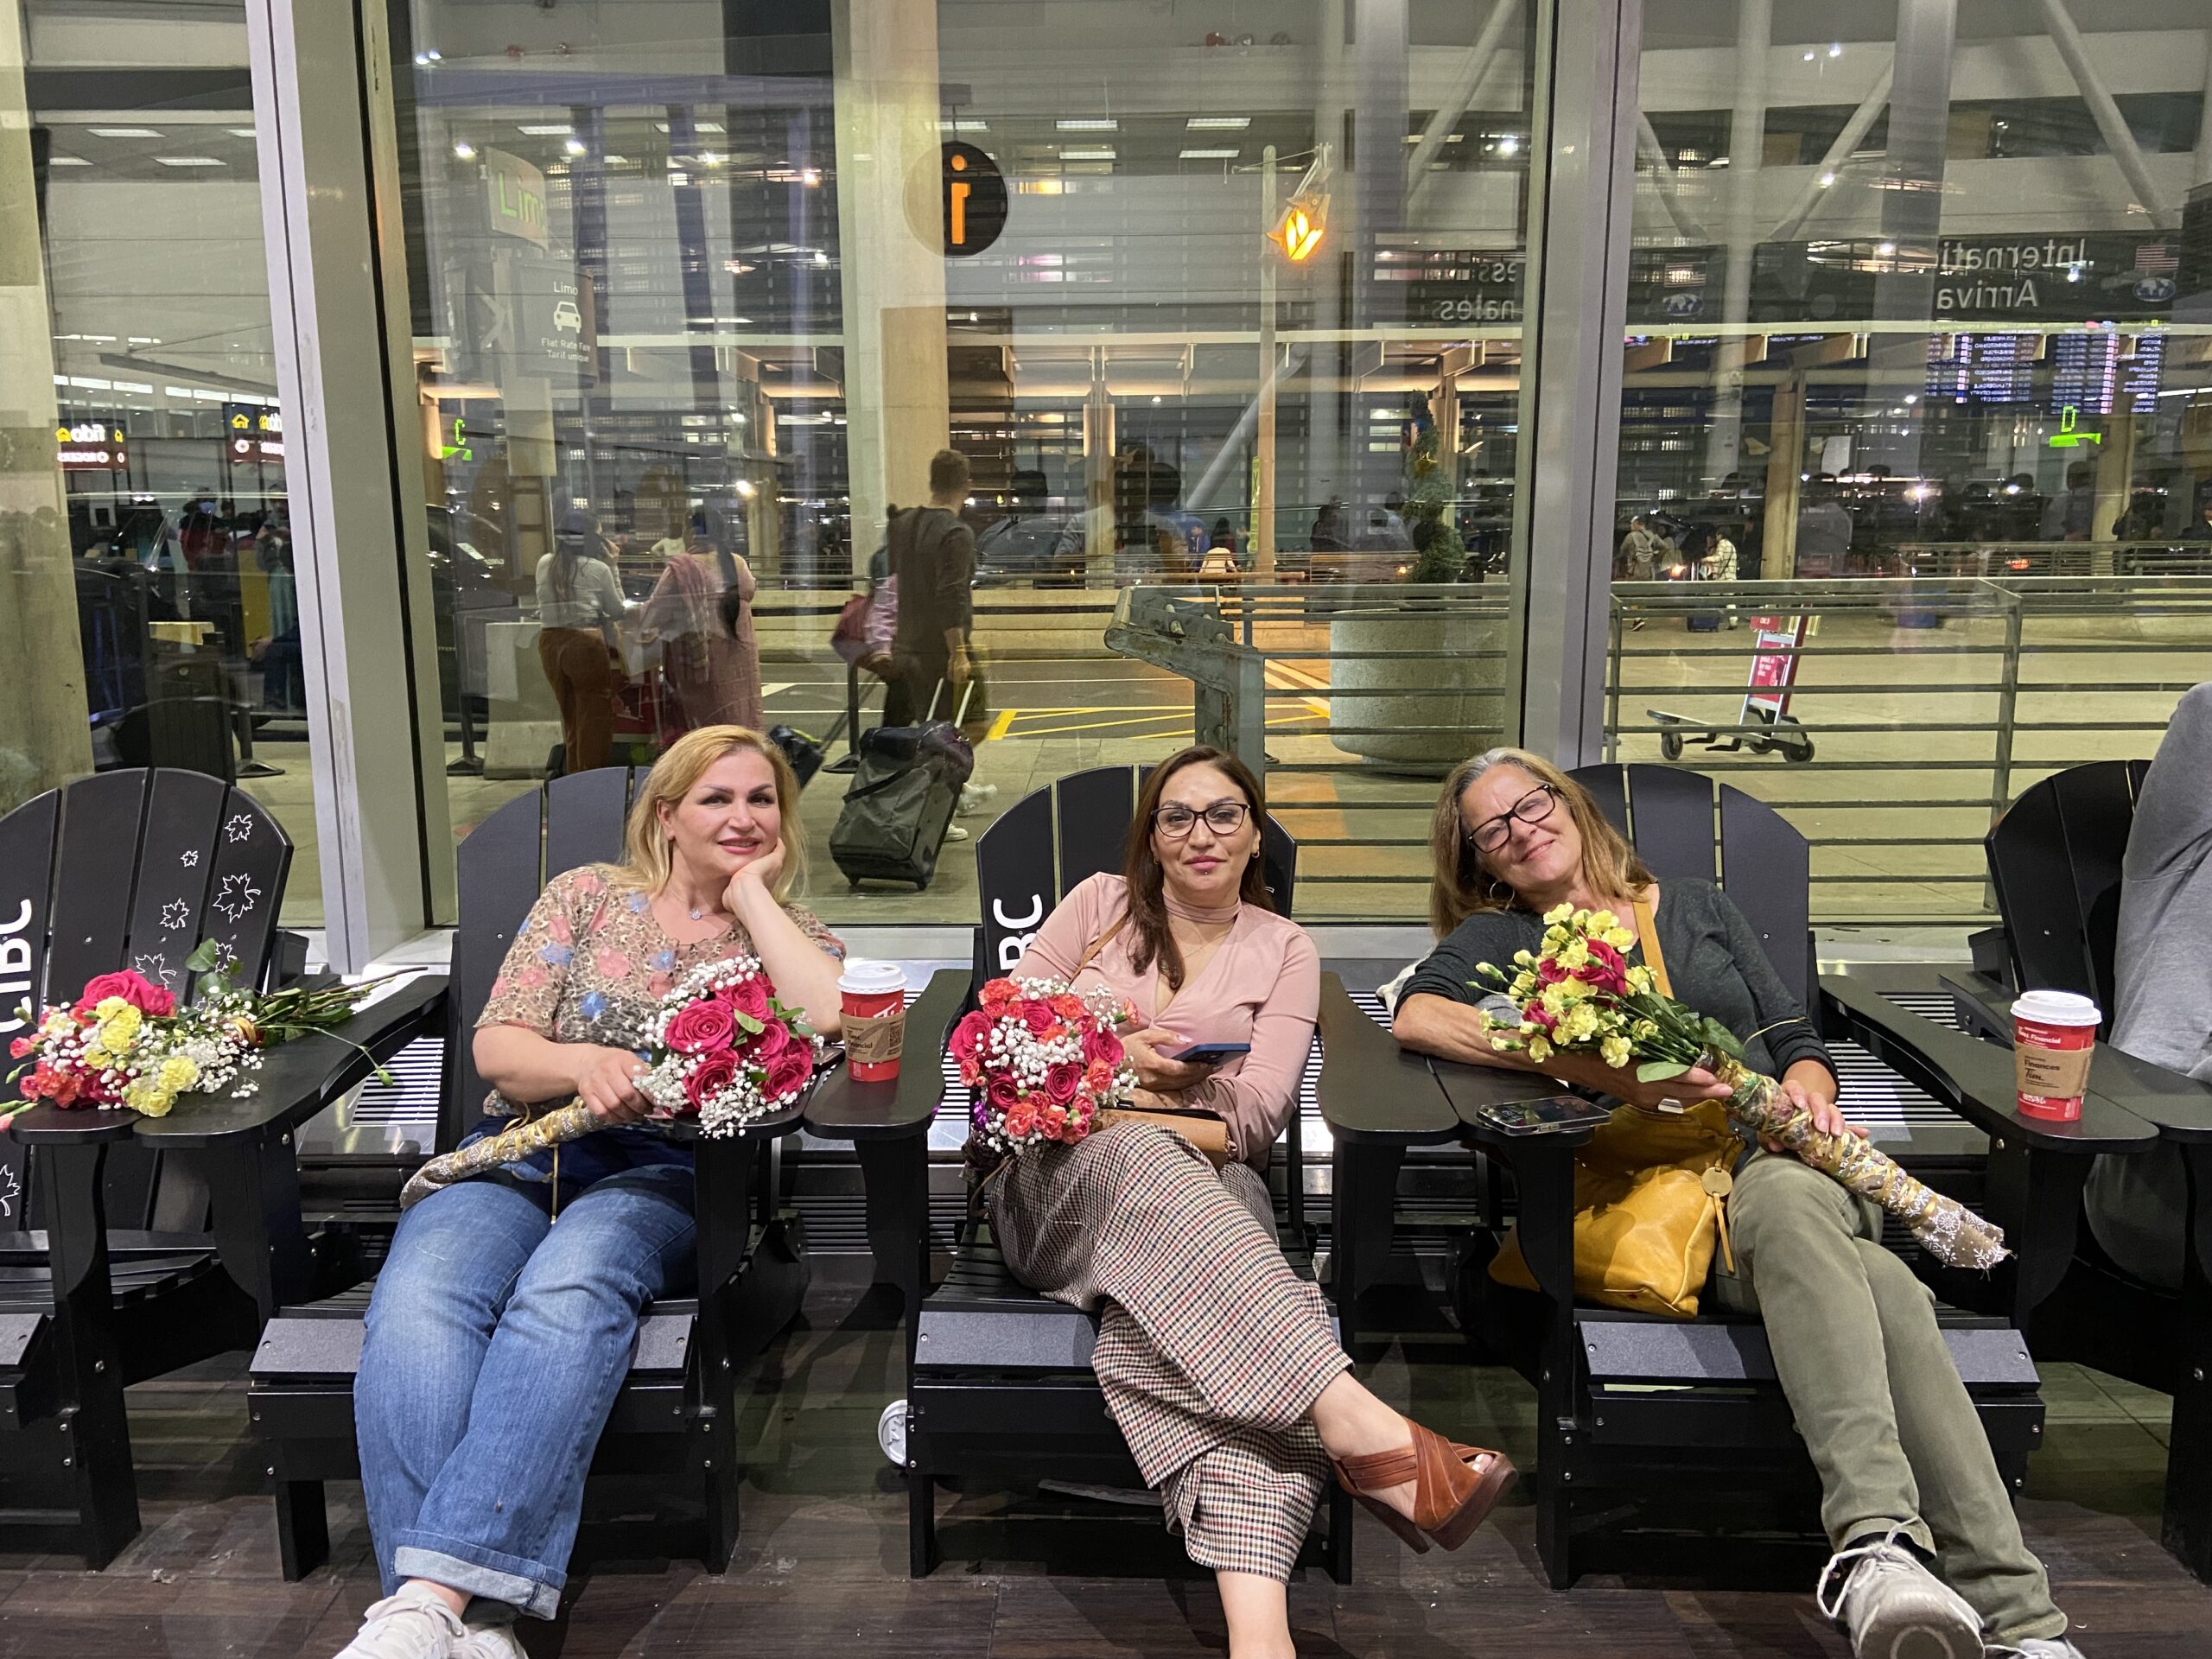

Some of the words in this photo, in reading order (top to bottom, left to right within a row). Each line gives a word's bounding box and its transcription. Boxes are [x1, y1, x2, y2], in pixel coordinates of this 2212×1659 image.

[553, 281, 579, 296] Limo
[541, 338, 558, 347] Flat
[560, 340, 578, 350] Rate
[546, 349, 566, 359] Tarif
[2024, 1058, 2061, 1071] Finances
